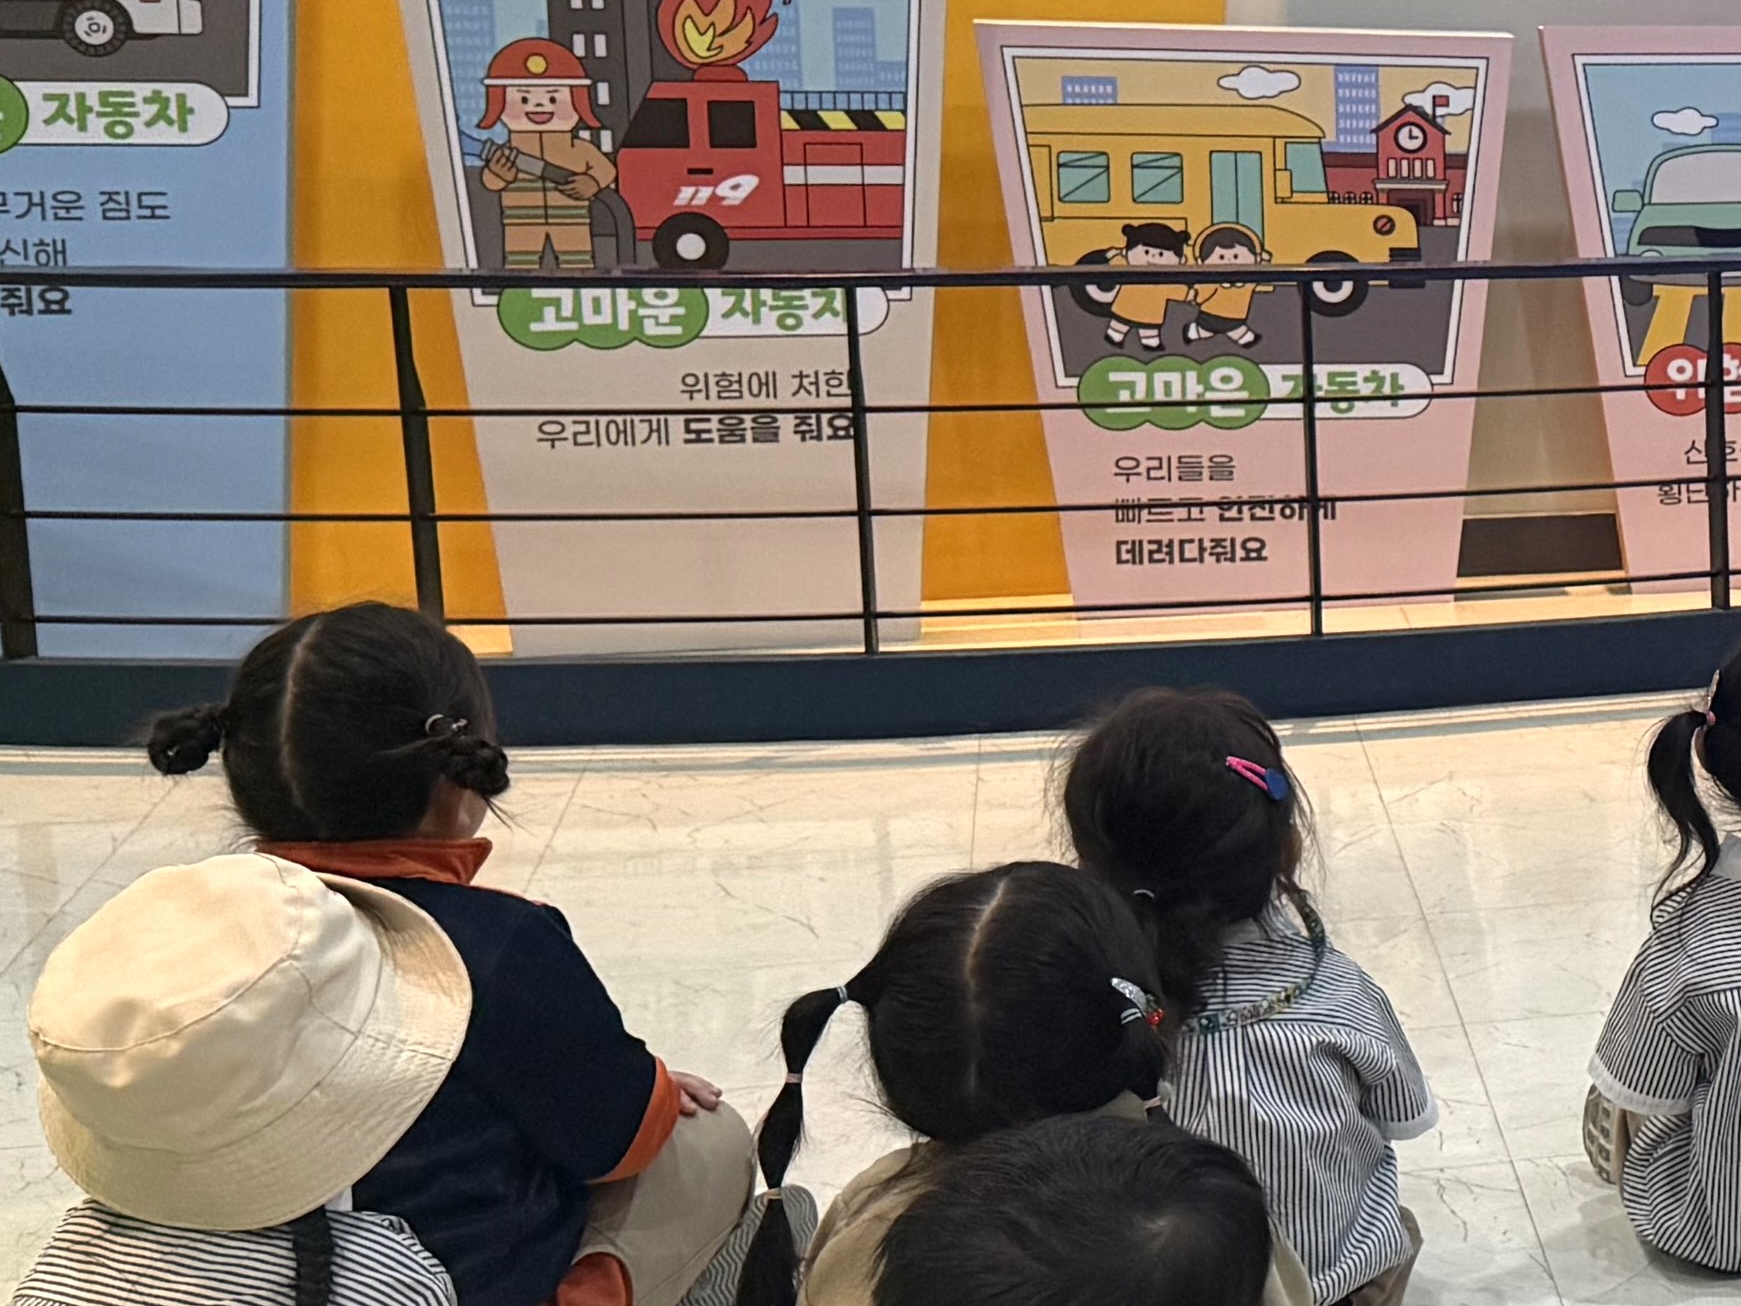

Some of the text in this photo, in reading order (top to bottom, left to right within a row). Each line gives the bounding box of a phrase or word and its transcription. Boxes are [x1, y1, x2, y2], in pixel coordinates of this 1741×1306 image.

[42, 90, 195, 140] 자동차
[99, 190, 171, 222] 짐도
[673, 174, 760, 206] 119
[529, 288, 686, 335] 고마운
[680, 371, 778, 400] 위험에
[1105, 366, 1250, 417] 고마운
[537, 413, 854, 448] 우리에게 도움을 줘요
[1113, 454, 1235, 482] 우리들을
[1116, 537, 1268, 565] 데려다줘요
